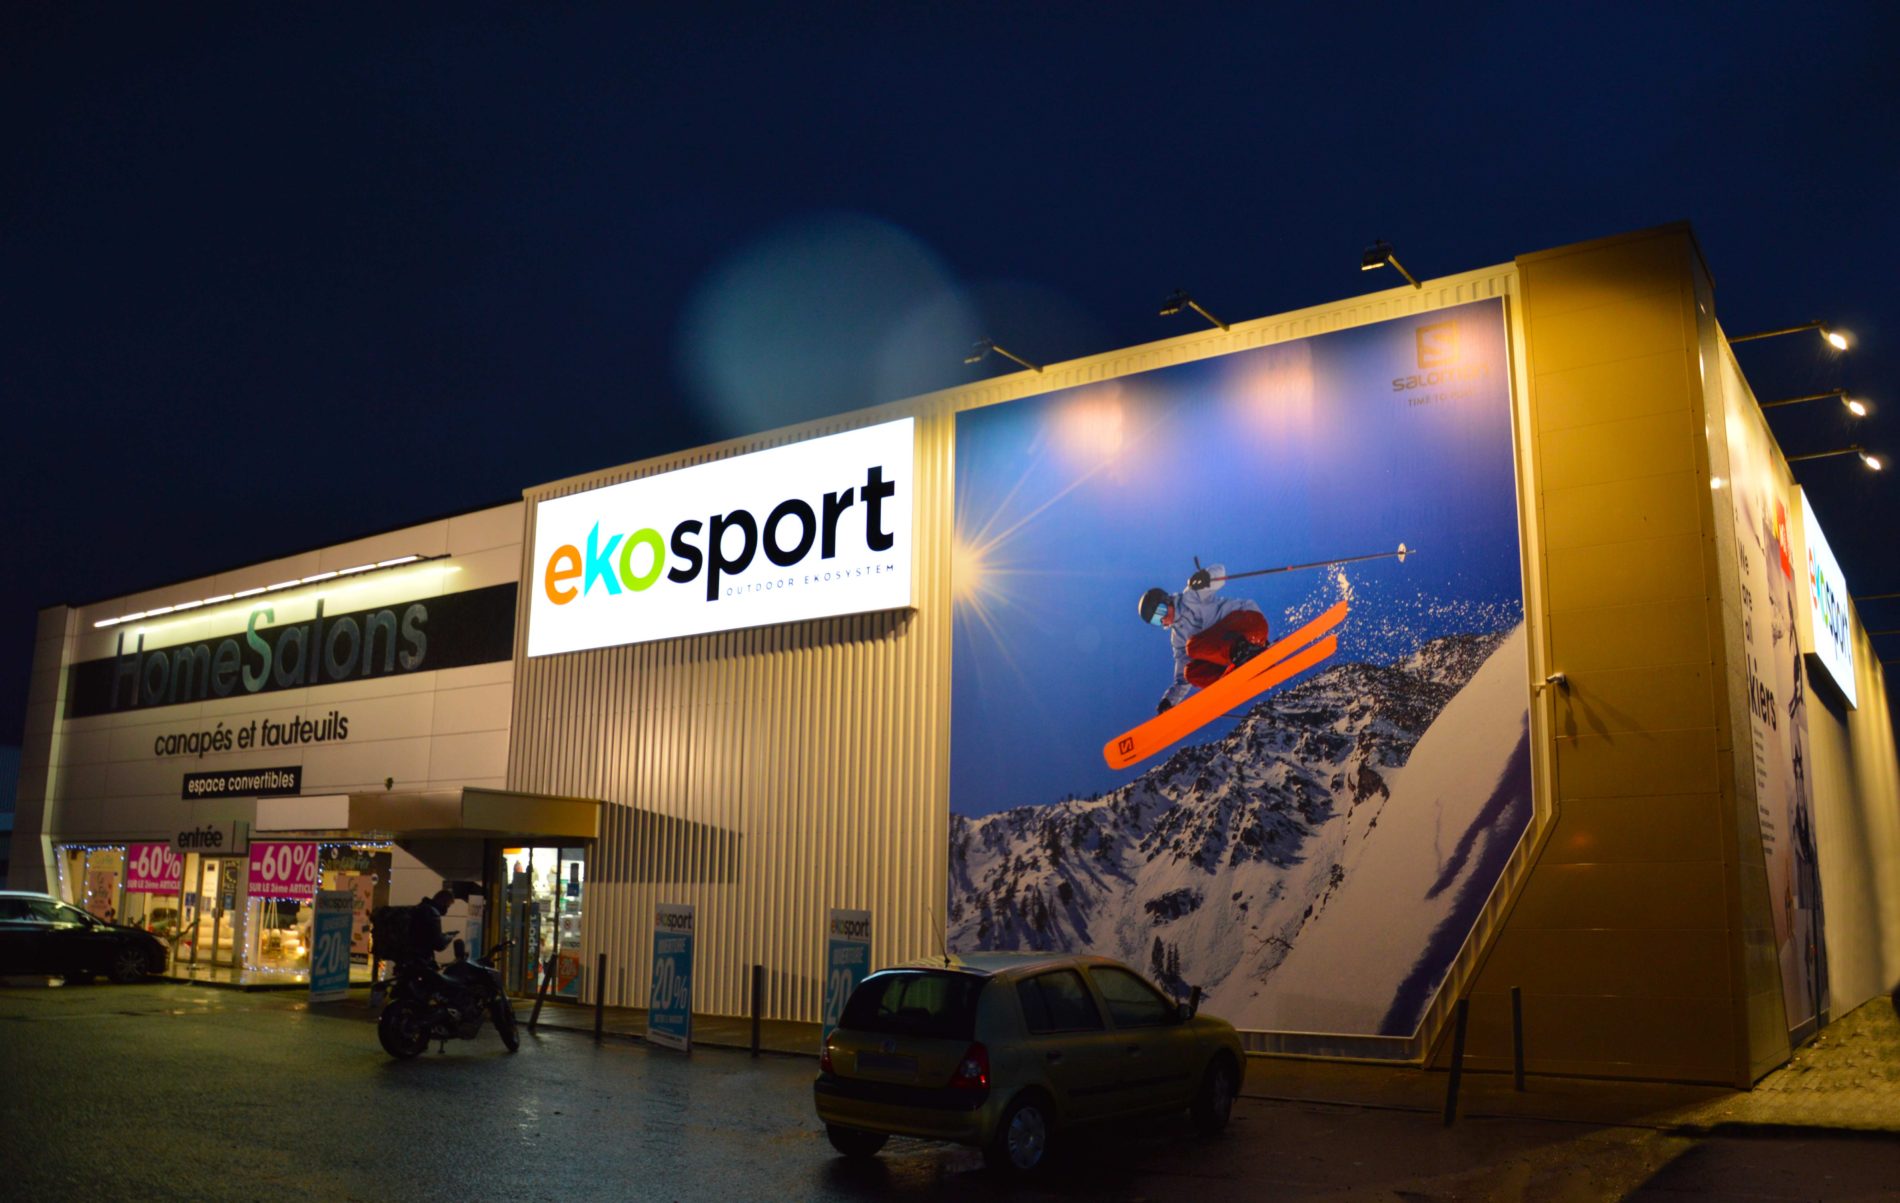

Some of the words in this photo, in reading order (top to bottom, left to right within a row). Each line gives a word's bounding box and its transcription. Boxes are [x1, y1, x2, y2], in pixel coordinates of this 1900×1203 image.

[545, 466, 895, 605] ekosport
[726, 578, 795, 597] OUTDOOR
[803, 564, 895, 586] EKOSYSTEM
[111, 597, 428, 709] HomeSalons
[1747, 653, 1777, 732] kiers
[154, 721, 233, 759] canapés
[237, 720, 257, 750] et
[261, 710, 349, 747] fauteuils
[187, 779, 226, 796] espace
[227, 770, 295, 792] convertibles
[177, 824, 223, 849] entrée
[130, 846, 181, 879] -60%
[251, 844, 315, 882] -60%
[249, 881, 262, 892] SUR
[263, 882, 270, 892] LE
